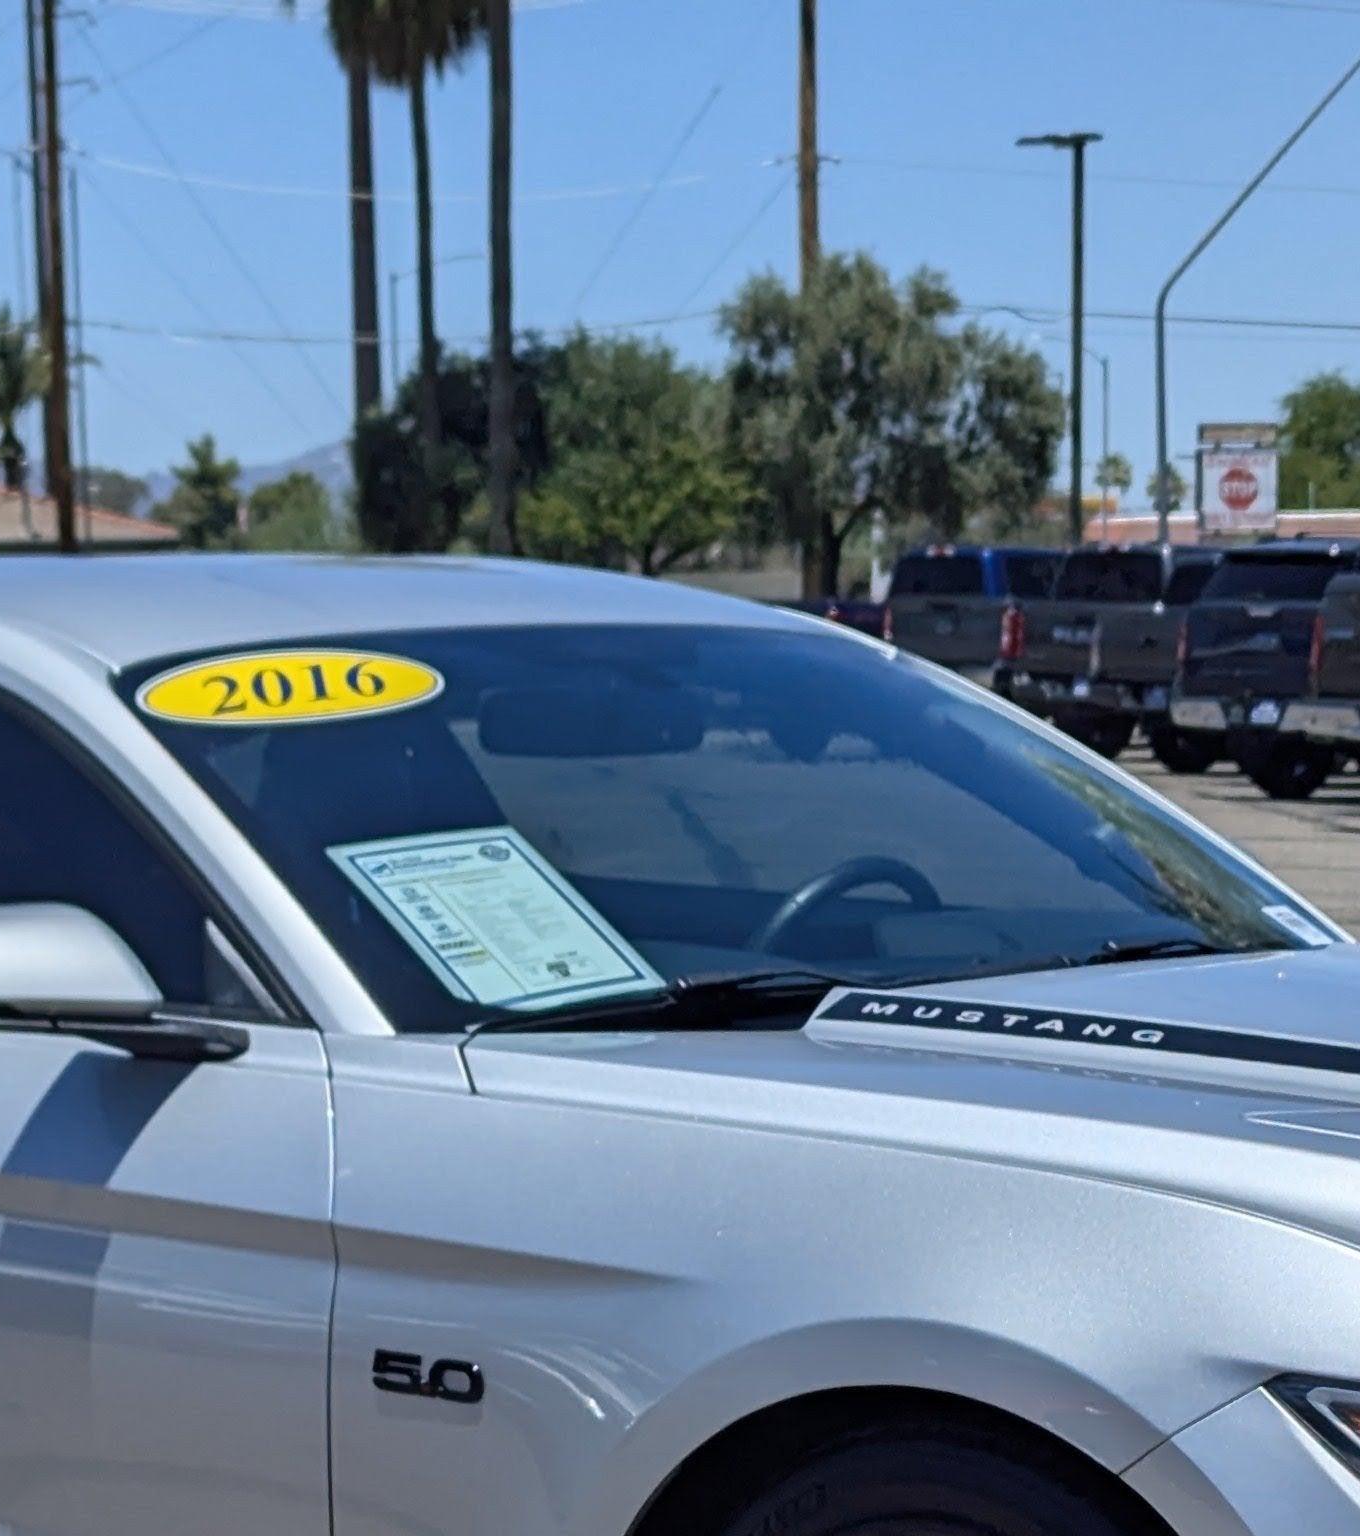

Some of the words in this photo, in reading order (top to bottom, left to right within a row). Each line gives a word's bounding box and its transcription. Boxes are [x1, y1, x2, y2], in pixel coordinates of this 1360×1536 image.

[201, 650, 387, 717] 2016
[860, 1001, 1166, 1044] MUSTANG
[371, 1347, 486, 1405] 5.0
